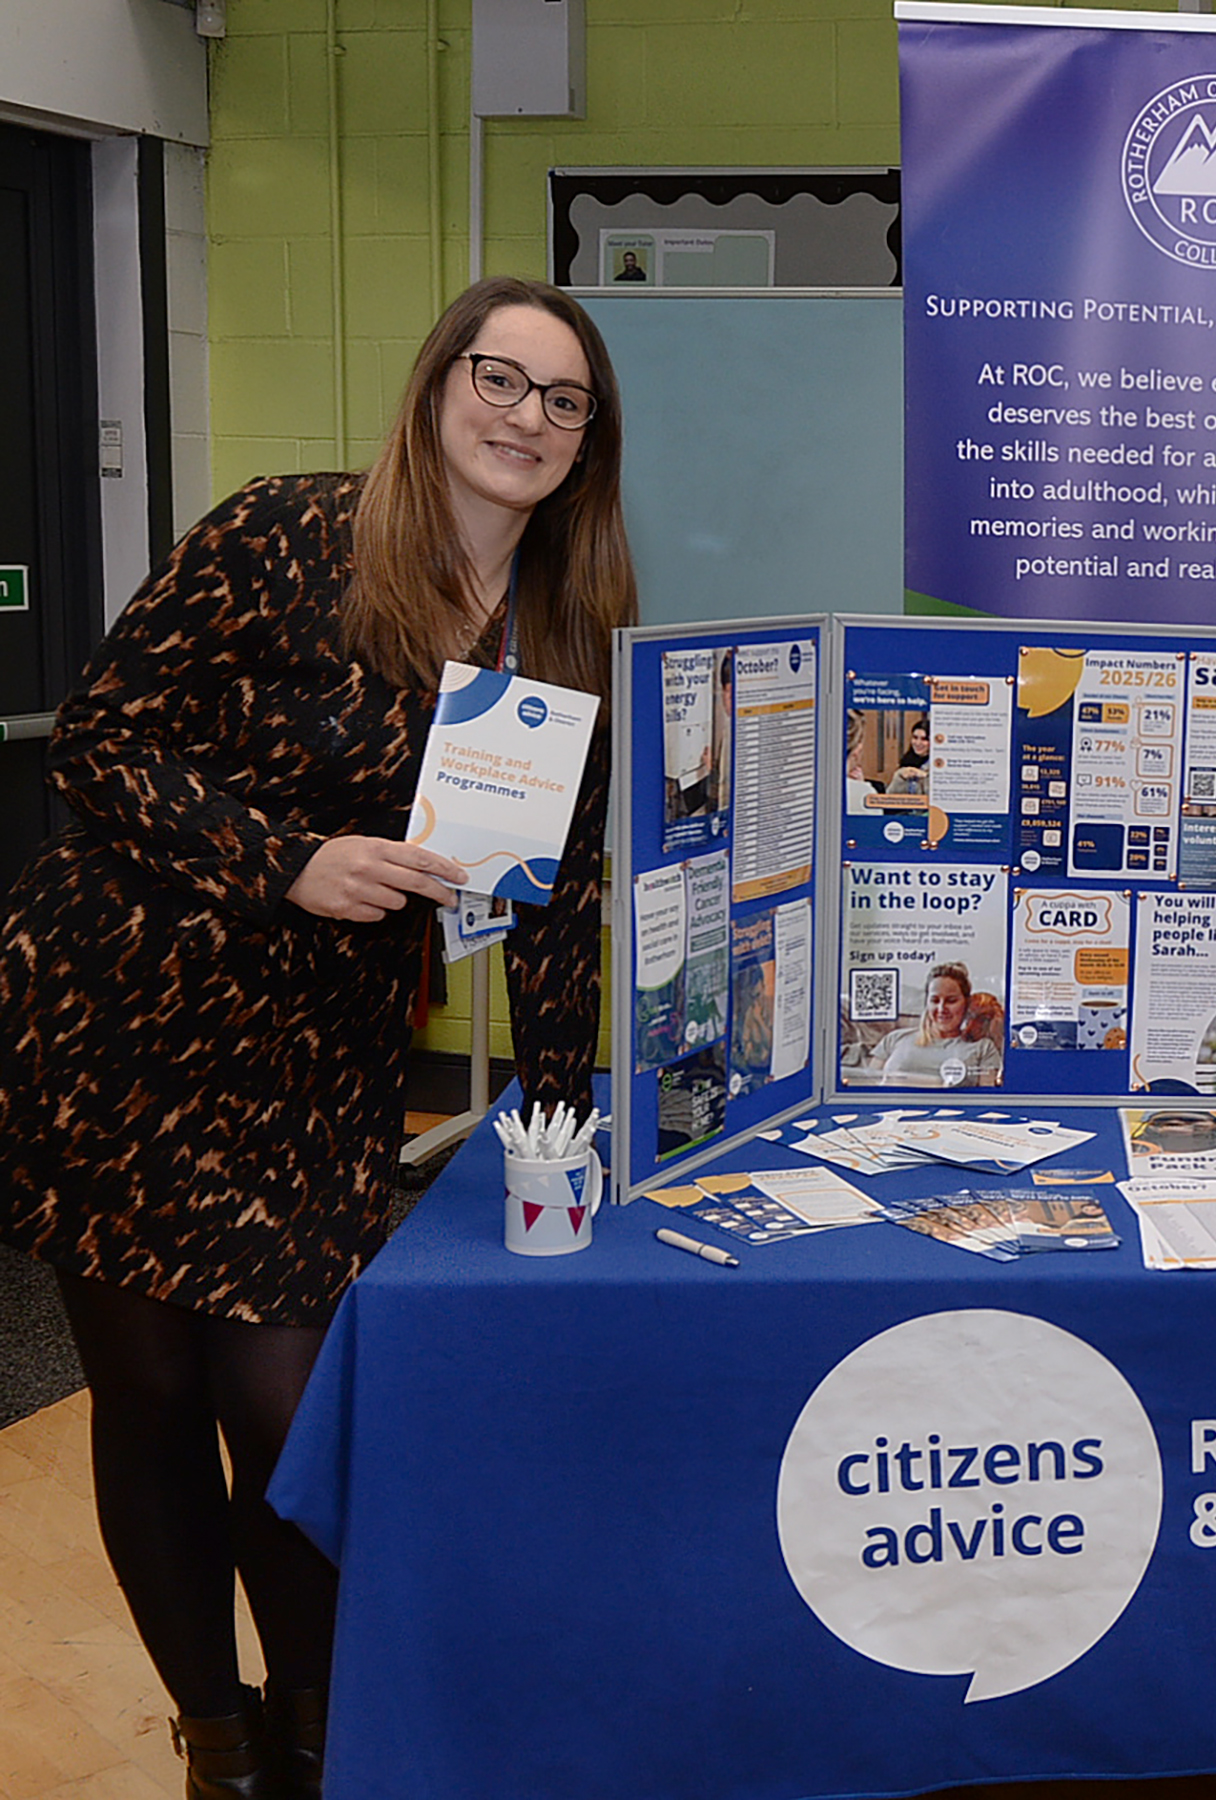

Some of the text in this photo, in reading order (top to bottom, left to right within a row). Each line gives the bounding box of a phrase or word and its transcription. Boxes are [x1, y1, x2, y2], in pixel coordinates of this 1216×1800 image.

[1127, 82, 1199, 205] ROTHERHAM
[926, 295, 1073, 320] SUPPORTING
[1084, 300, 1215, 329] POTENTIAL,
[978, 364, 1004, 387] At
[1013, 365, 1069, 391] ROC,
[1078, 371, 1112, 389] we
[1121, 368, 1203, 393] believe
[988, 403, 1091, 427] deserves
[1100, 405, 1137, 428] the
[1146, 408, 1196, 430] best
[957, 439, 994, 461] the
[1001, 439, 1059, 463] skills
[1068, 443, 1154, 467] needed
[1162, 445, 1196, 468] for
[1204, 452, 1216, 469] a
[989, 478, 1034, 499] into
[1043, 480, 1169, 508] adulthood,
[970, 517, 1083, 539] memories
[1092, 519, 1134, 541] and
[1015, 555, 1118, 580] potential
[1127, 557, 1170, 579] and
[737, 658, 779, 674] October?
[1086, 658, 1176, 670] Impact Numbers
[1100, 670, 1176, 687] 2025/26
[1144, 710, 1170, 721] 21%
[444, 742, 532, 771] Training and
[1095, 740, 1125, 752] 77%
[1143, 749, 1162, 759] 7%
[436, 771, 526, 801] Programmes
[440, 756, 566, 794] Workplace Advice
[1095, 776, 1126, 788] 91%
[1141, 787, 1167, 798] 61%
[851, 868, 996, 891] Want to stay
[851, 892, 982, 914] in the loop?
[1154, 895, 1189, 909] You
[1192, 896, 1216, 909] will
[1039, 910, 1098, 927] CARD
[1153, 911, 1210, 927] helping
[1153, 928, 1204, 943] people
[850, 950, 936, 963] Sign up today!
[1152, 944, 1208, 957] Sarah...
[836, 1432, 1105, 1495] citizens
[861, 1503, 1085, 1568] advice
